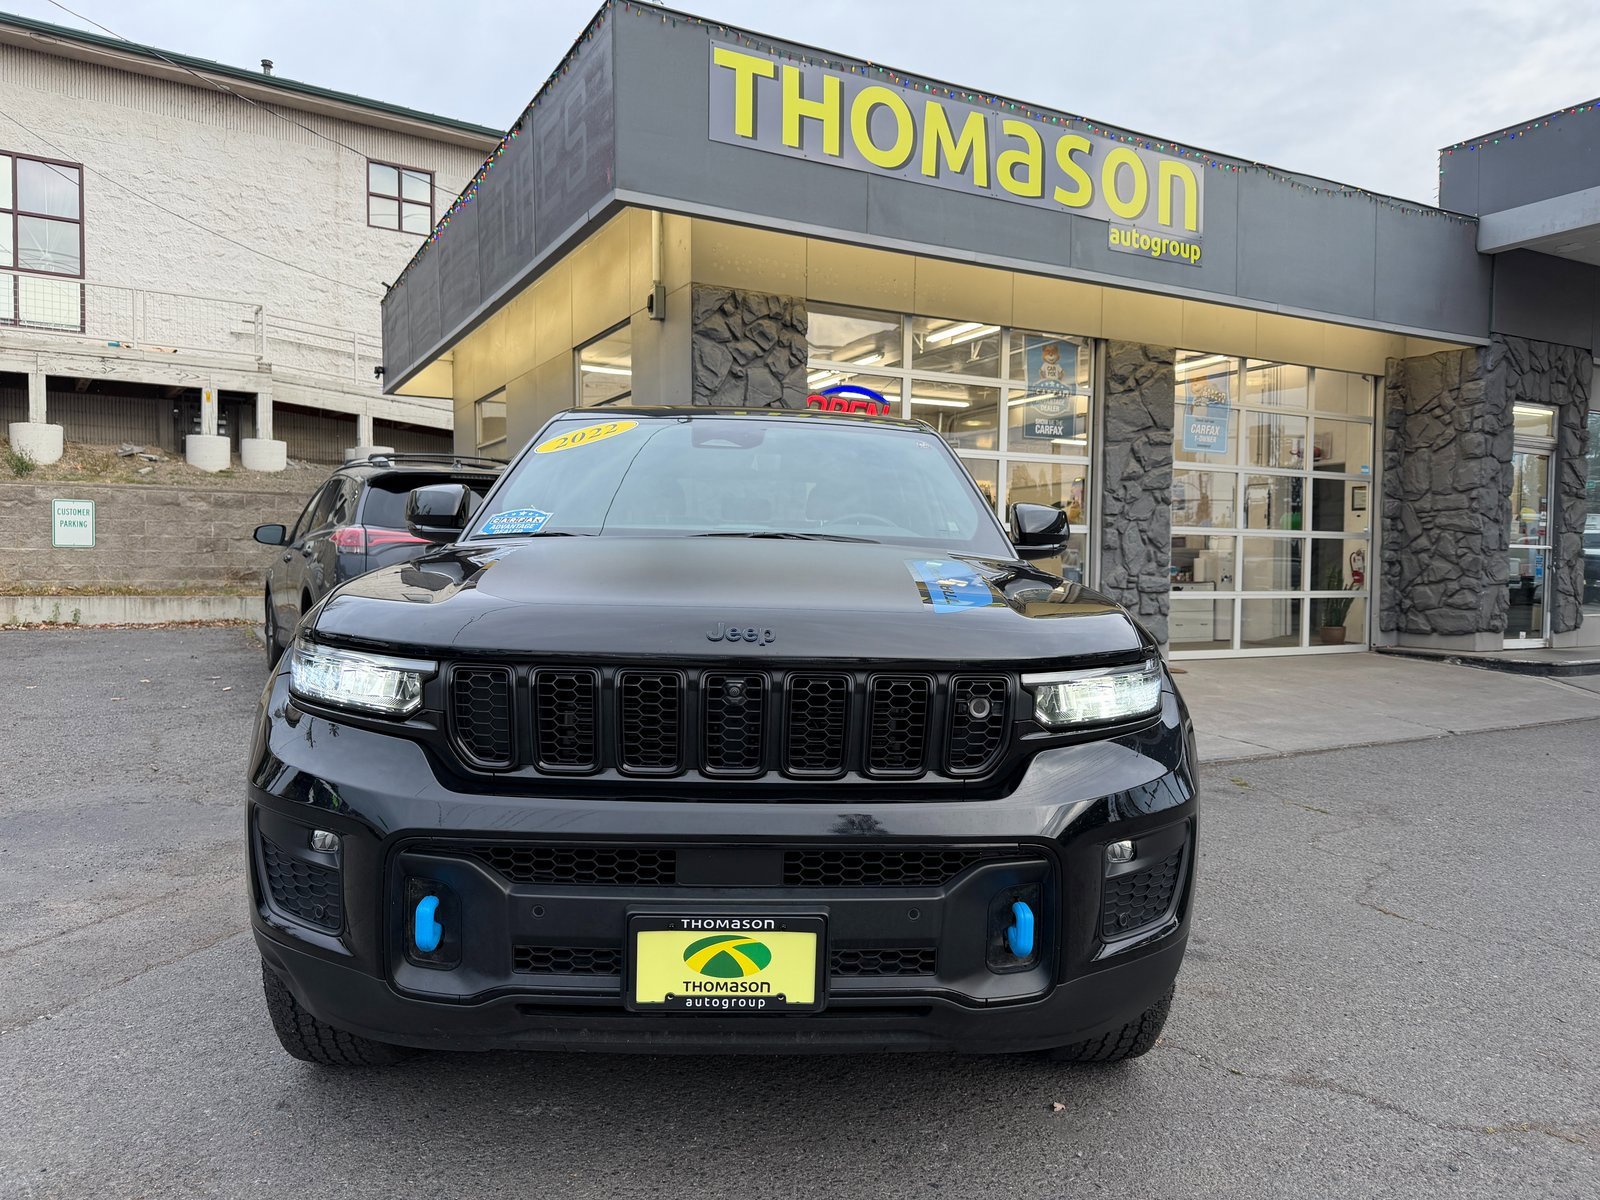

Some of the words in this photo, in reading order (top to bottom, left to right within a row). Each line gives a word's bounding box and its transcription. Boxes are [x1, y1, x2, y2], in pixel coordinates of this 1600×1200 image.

[1110, 228, 1201, 264] autogroup
[1035, 424, 1064, 435] CARFAX
[1191, 423, 1220, 435] CARFAX
[554, 423, 618, 449] 2022
[59, 520, 88, 528] PARKING
[706, 622, 776, 646] Jeep
[685, 997, 766, 1009] autogroup
